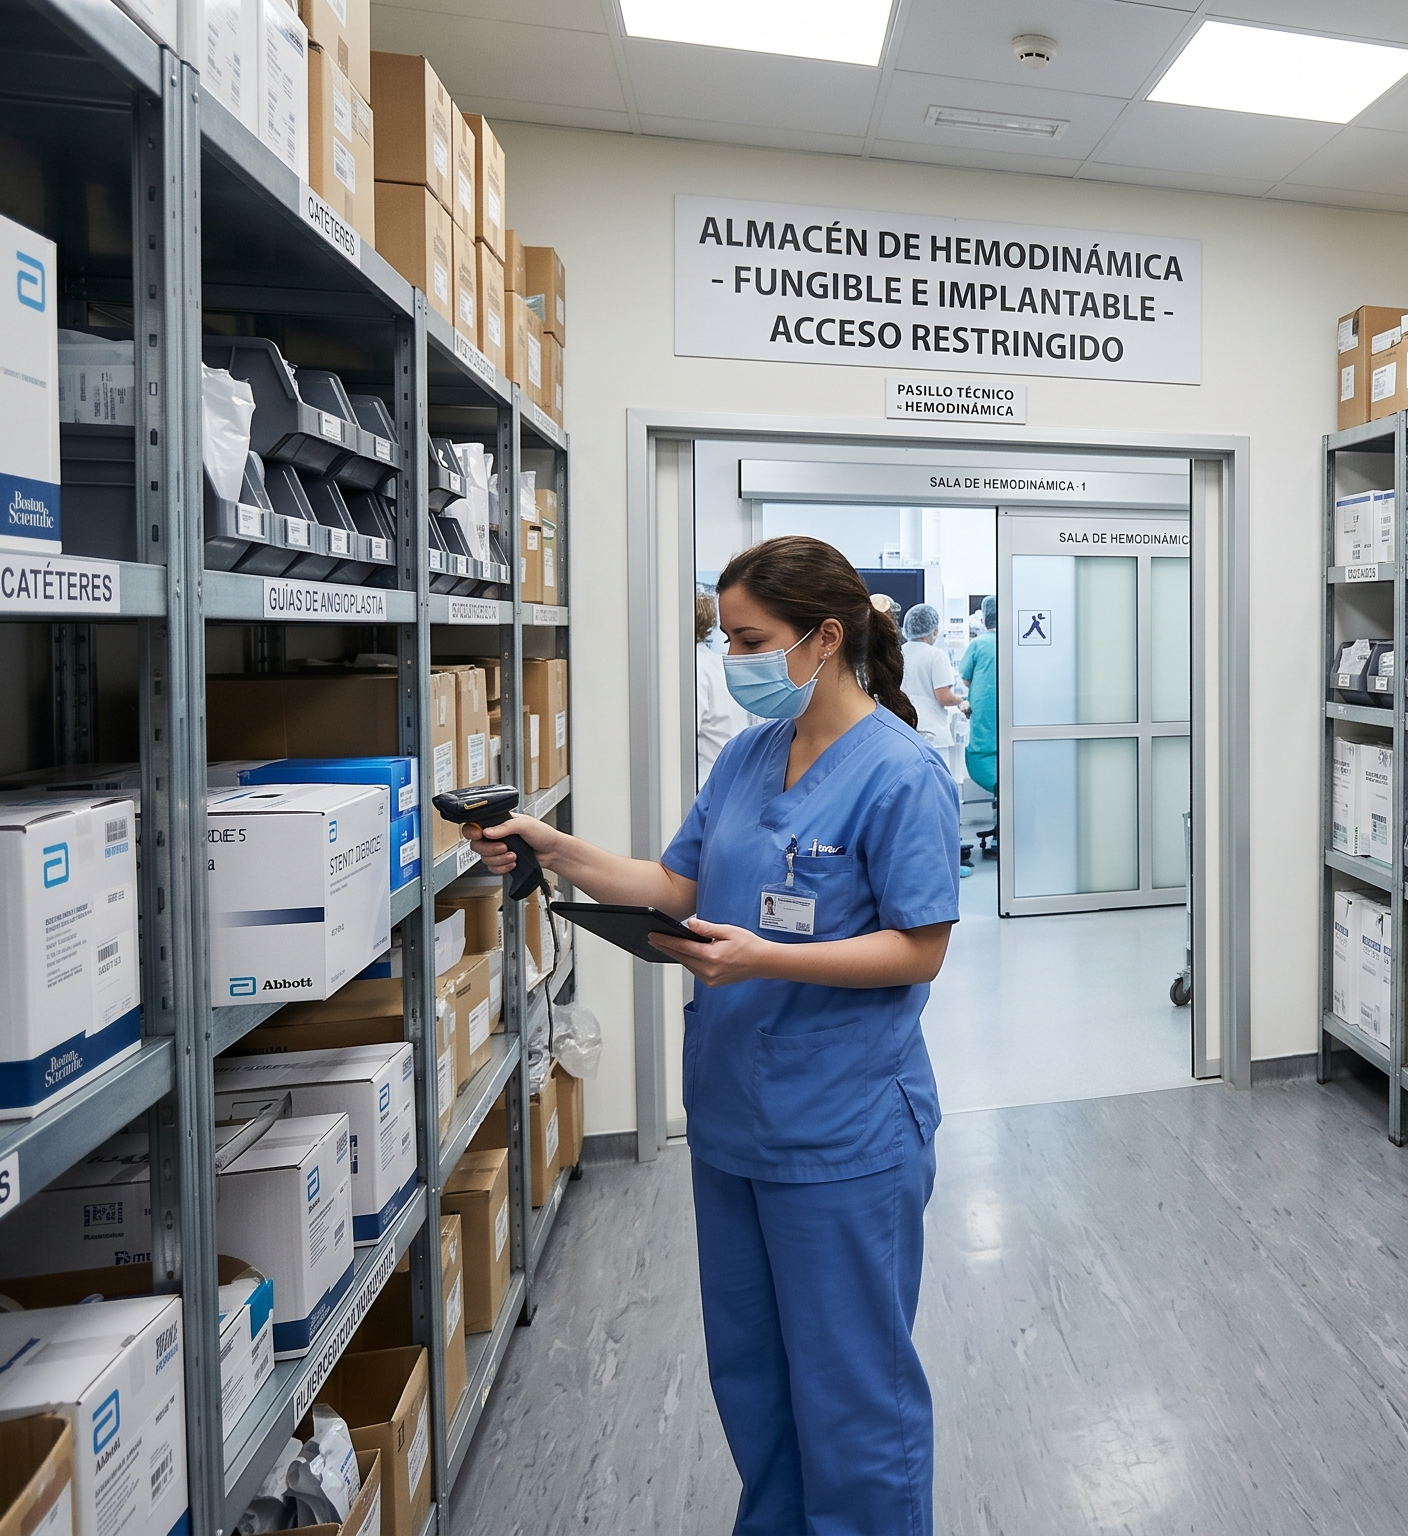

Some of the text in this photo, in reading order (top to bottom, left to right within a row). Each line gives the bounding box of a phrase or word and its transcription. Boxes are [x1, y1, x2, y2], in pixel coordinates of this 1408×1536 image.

[308, 197, 355, 256] CATÉTERES
[699, 216, 1183, 282] ALMACÉN DE HEMODINÁMICA
[735, 265, 901, 305] FUNGIBLE
[913, 279, 928, 306] E
[939, 280, 1155, 322] IMPLANTABLE
[770, 314, 1123, 362] ACCESO RESTRINGIDO
[897, 384, 1014, 401] PASILLO TÉCNICO
[905, 399, 1014, 417] HEMODINÁMICA
[930, 476, 960, 489] SALA
[965, 477, 980, 490] DE
[984, 475, 1073, 492] HEMODINÁMICA
[1059, 532, 1190, 546] SALA DE HEMODINÁMIC
[1, 561, 113, 603] CATÉTERES
[268, 582, 383, 616] GUÍAS DE ANGIOPLASTIA
[262, 977, 313, 990] Abbott
